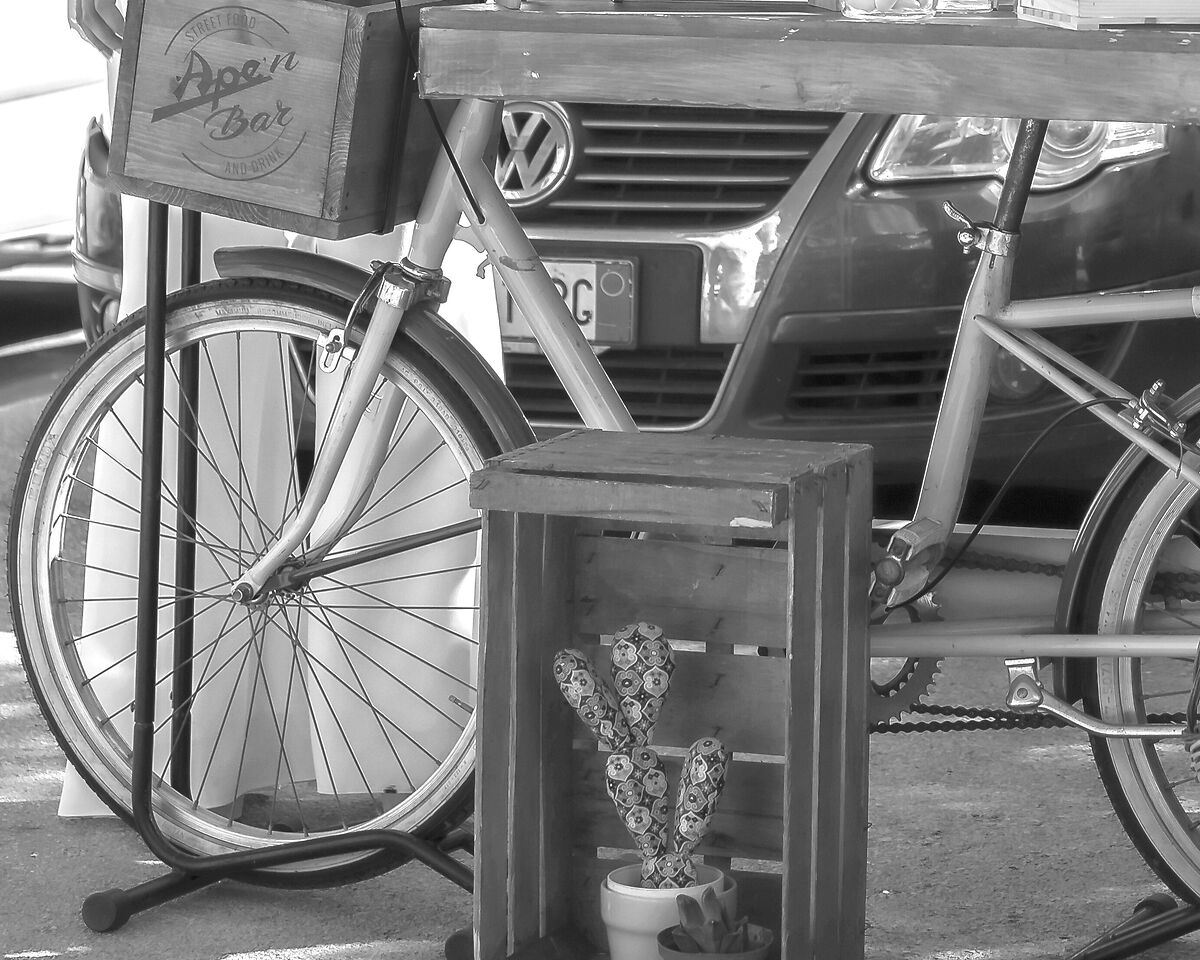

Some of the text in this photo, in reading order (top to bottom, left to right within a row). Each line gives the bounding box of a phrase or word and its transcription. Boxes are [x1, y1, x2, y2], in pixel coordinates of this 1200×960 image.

[184, 11, 257, 43] STREET FOOD
[203, 99, 294, 141] Bar
[224, 147, 285, 176] AND DRINK
